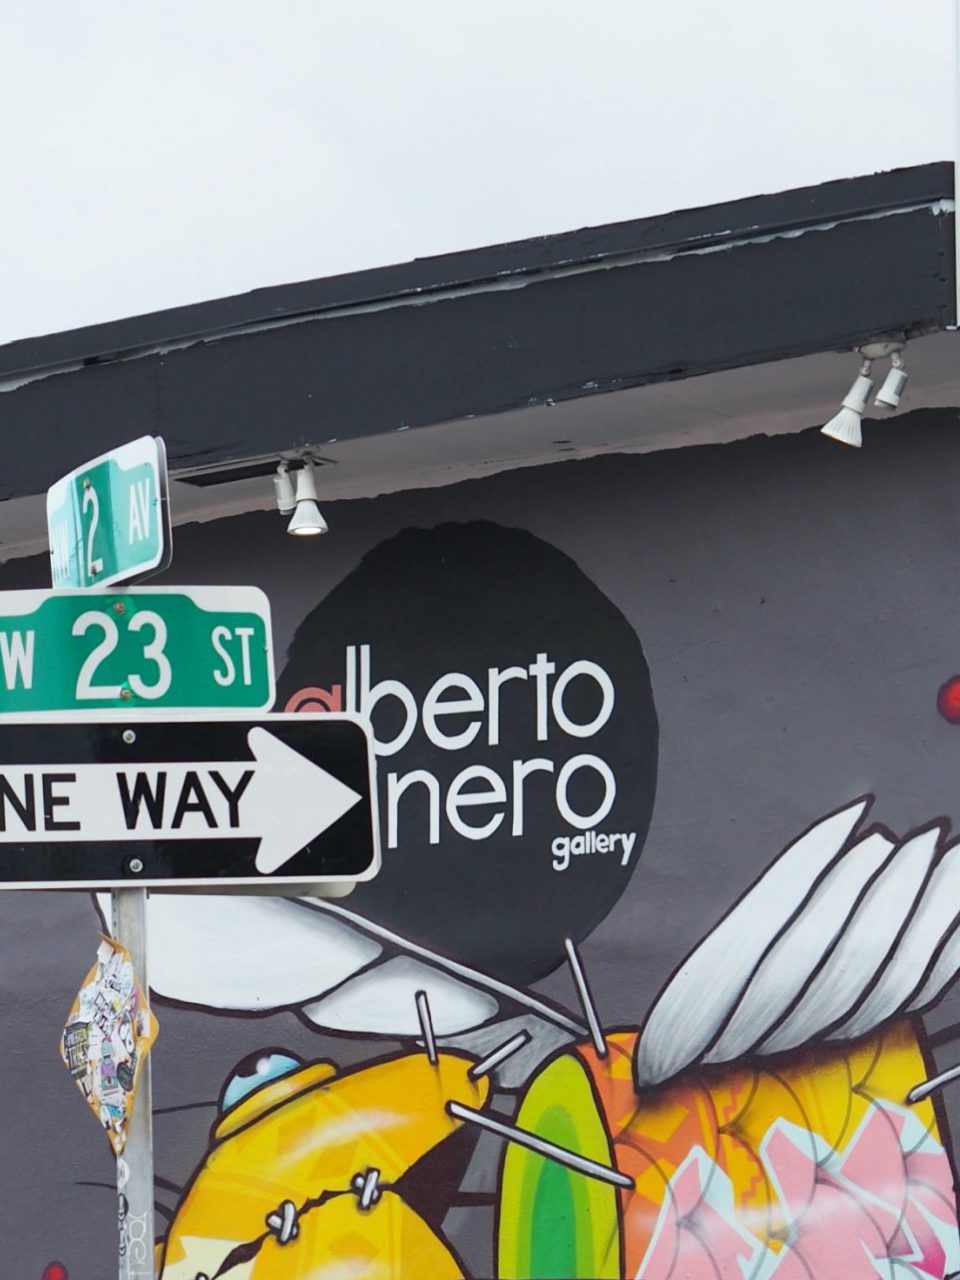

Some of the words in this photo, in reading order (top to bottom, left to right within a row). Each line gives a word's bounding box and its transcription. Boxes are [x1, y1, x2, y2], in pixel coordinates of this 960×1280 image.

[82, 486, 104, 577] 2
[129, 478, 151, 545] AV
[71, 611, 173, 700] 23
[211, 627, 255, 687] ST
[117, 770, 256, 831] WAY
[387, 753, 617, 849] nero
[551, 830, 637, 871] gallery
